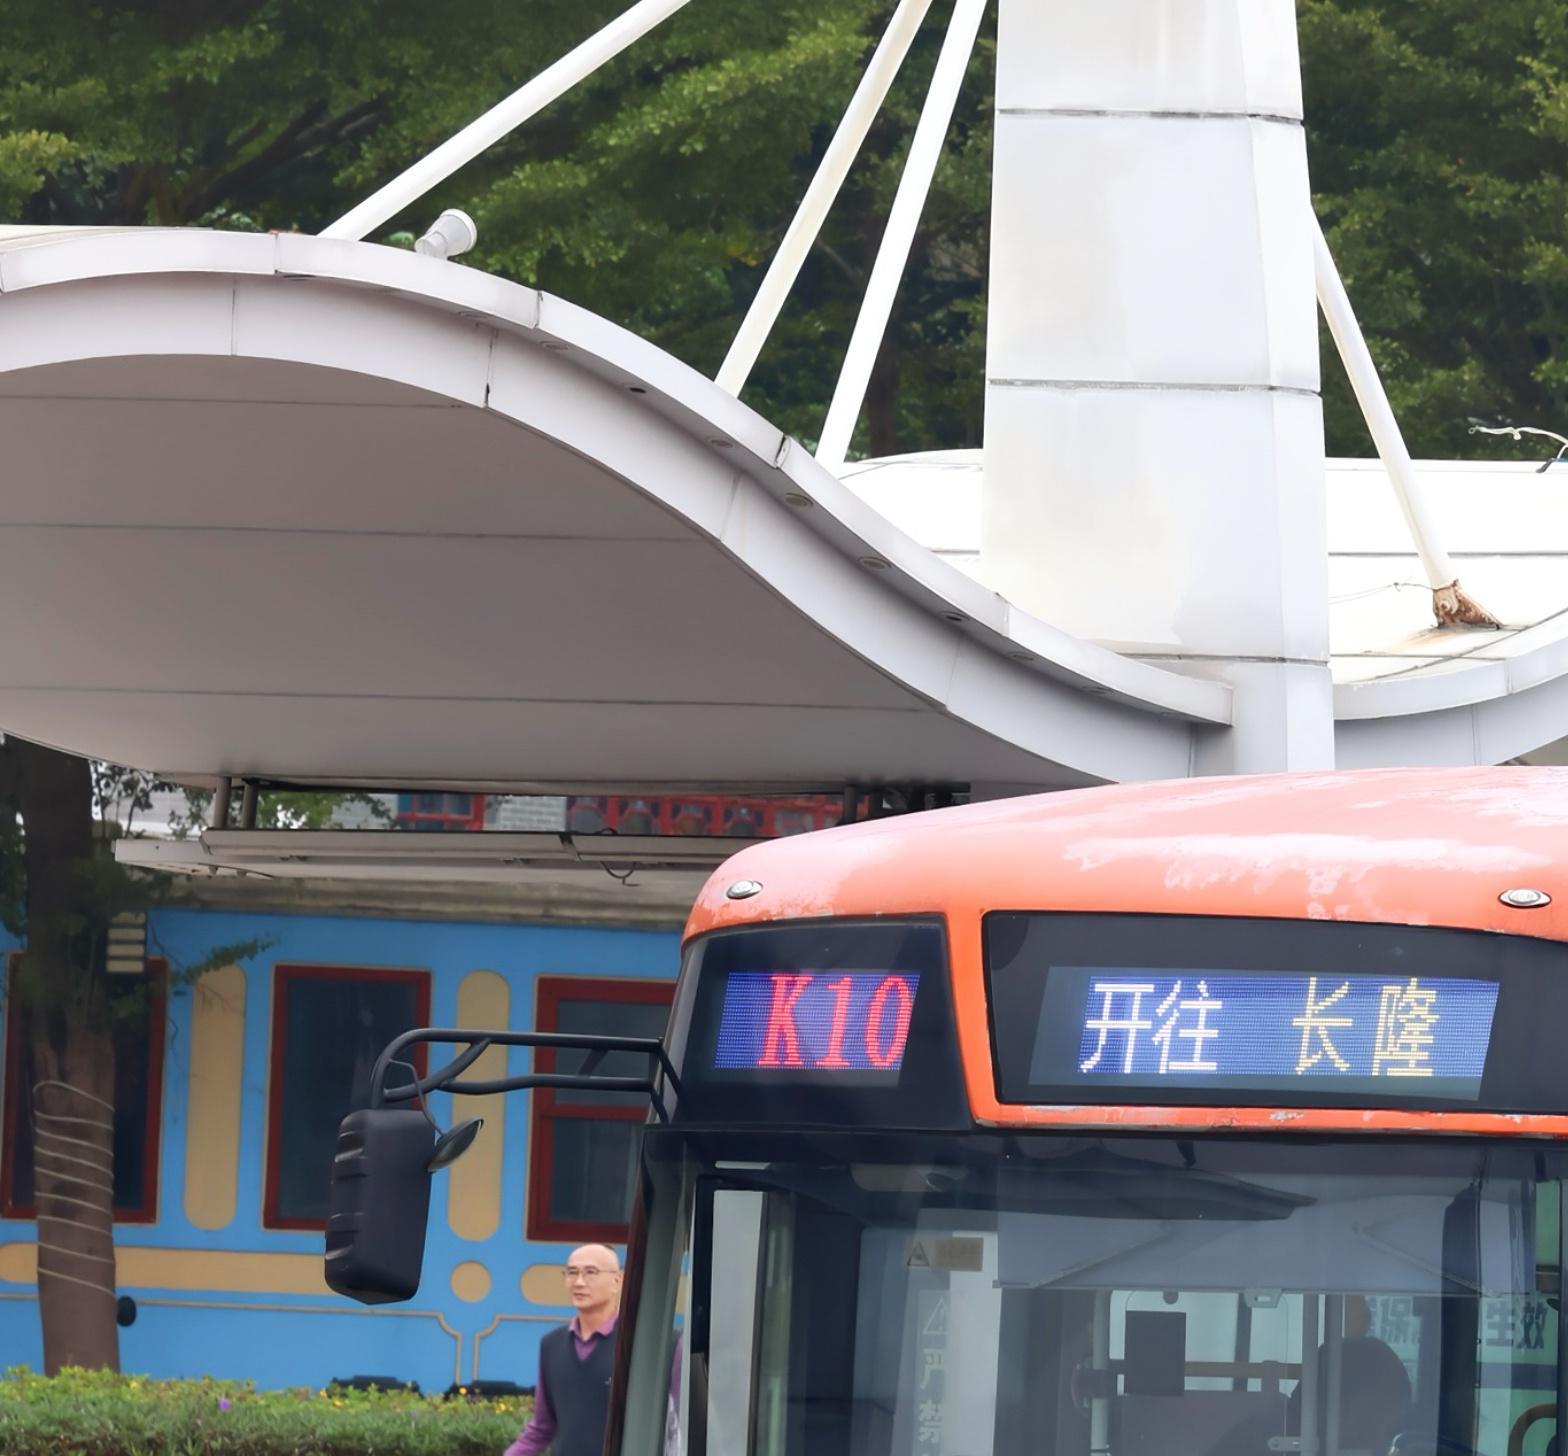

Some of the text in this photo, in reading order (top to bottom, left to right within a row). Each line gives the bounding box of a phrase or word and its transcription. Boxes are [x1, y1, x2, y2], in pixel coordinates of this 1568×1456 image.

[757, 975, 914, 1067] K10
[1079, 976, 1441, 1076] 开往 长隆
